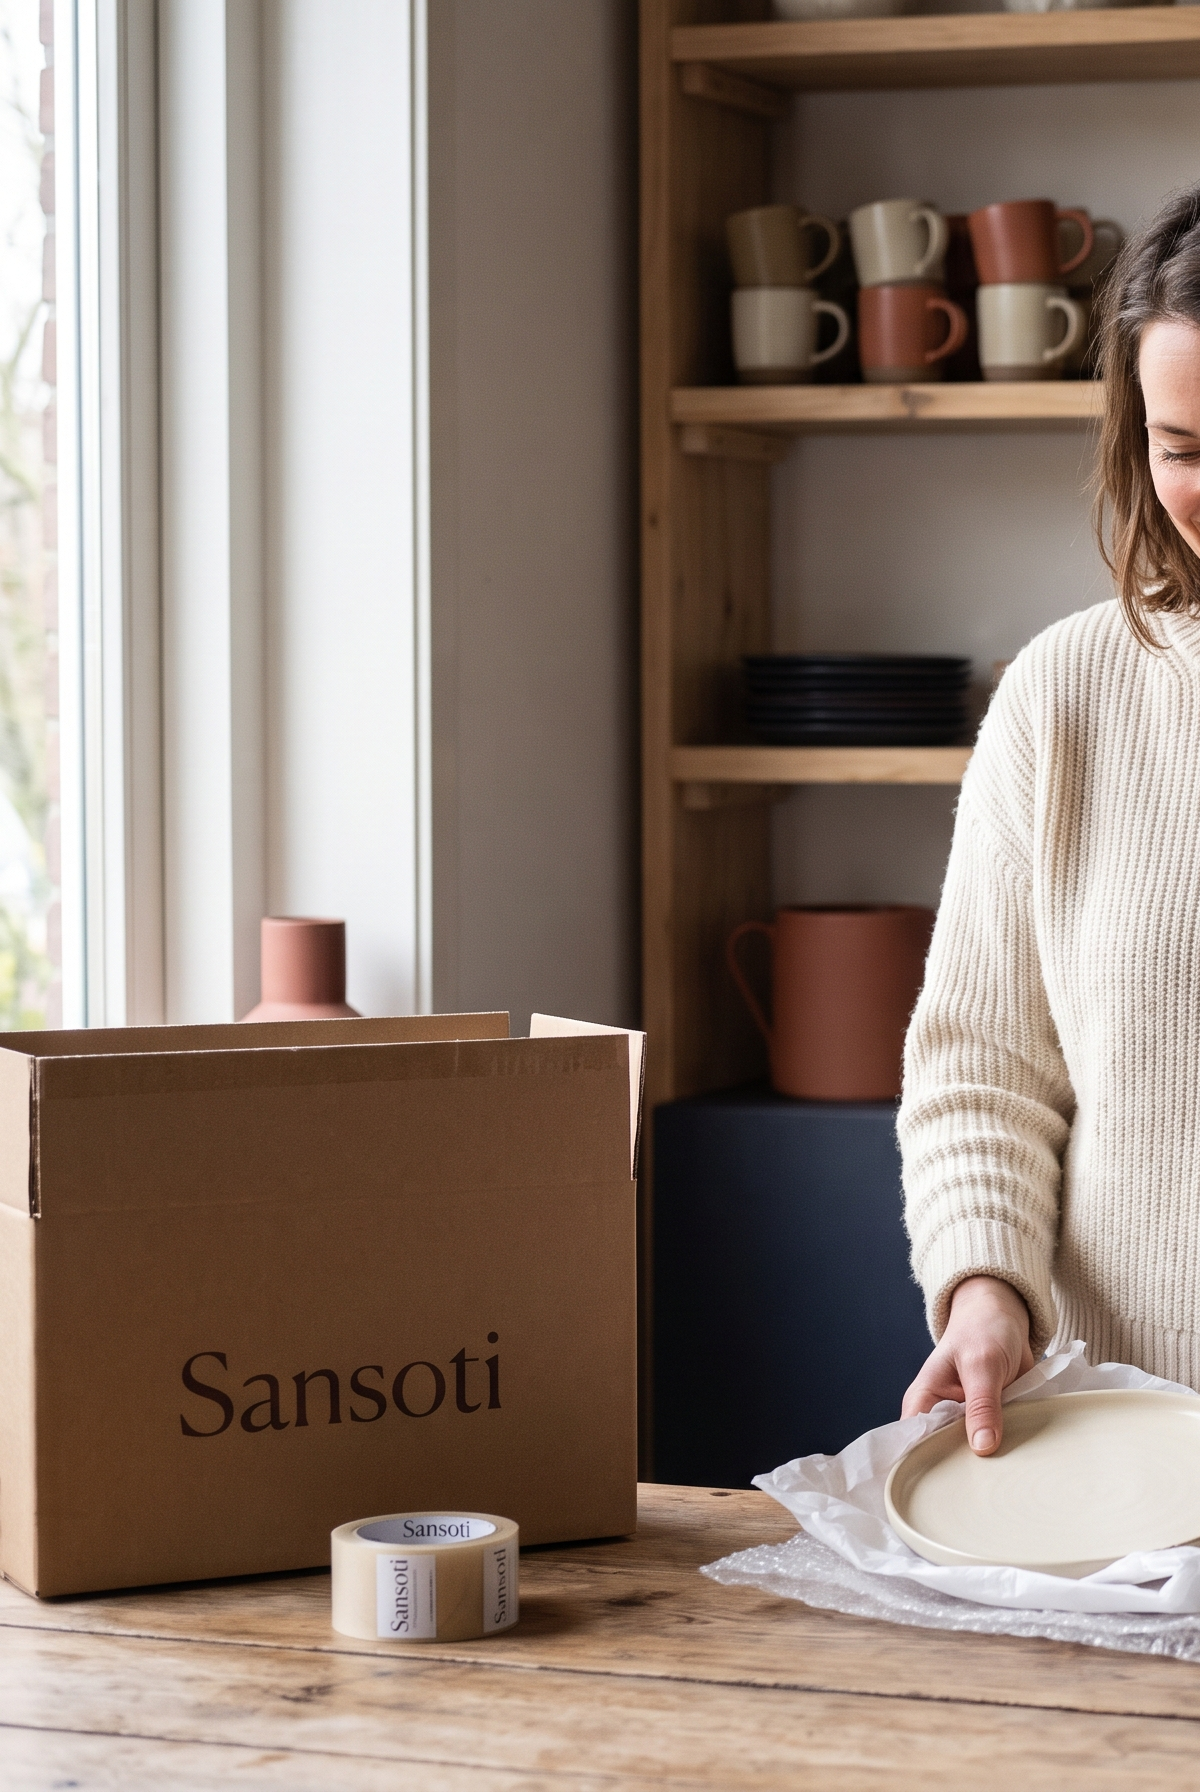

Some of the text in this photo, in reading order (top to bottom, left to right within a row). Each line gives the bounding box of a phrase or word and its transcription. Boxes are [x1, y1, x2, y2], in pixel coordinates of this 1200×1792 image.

[180, 1331, 502, 1437] Sansoti
[403, 1520, 470, 1538] Sansoti
[390, 1559, 409, 1633] Sansoti
